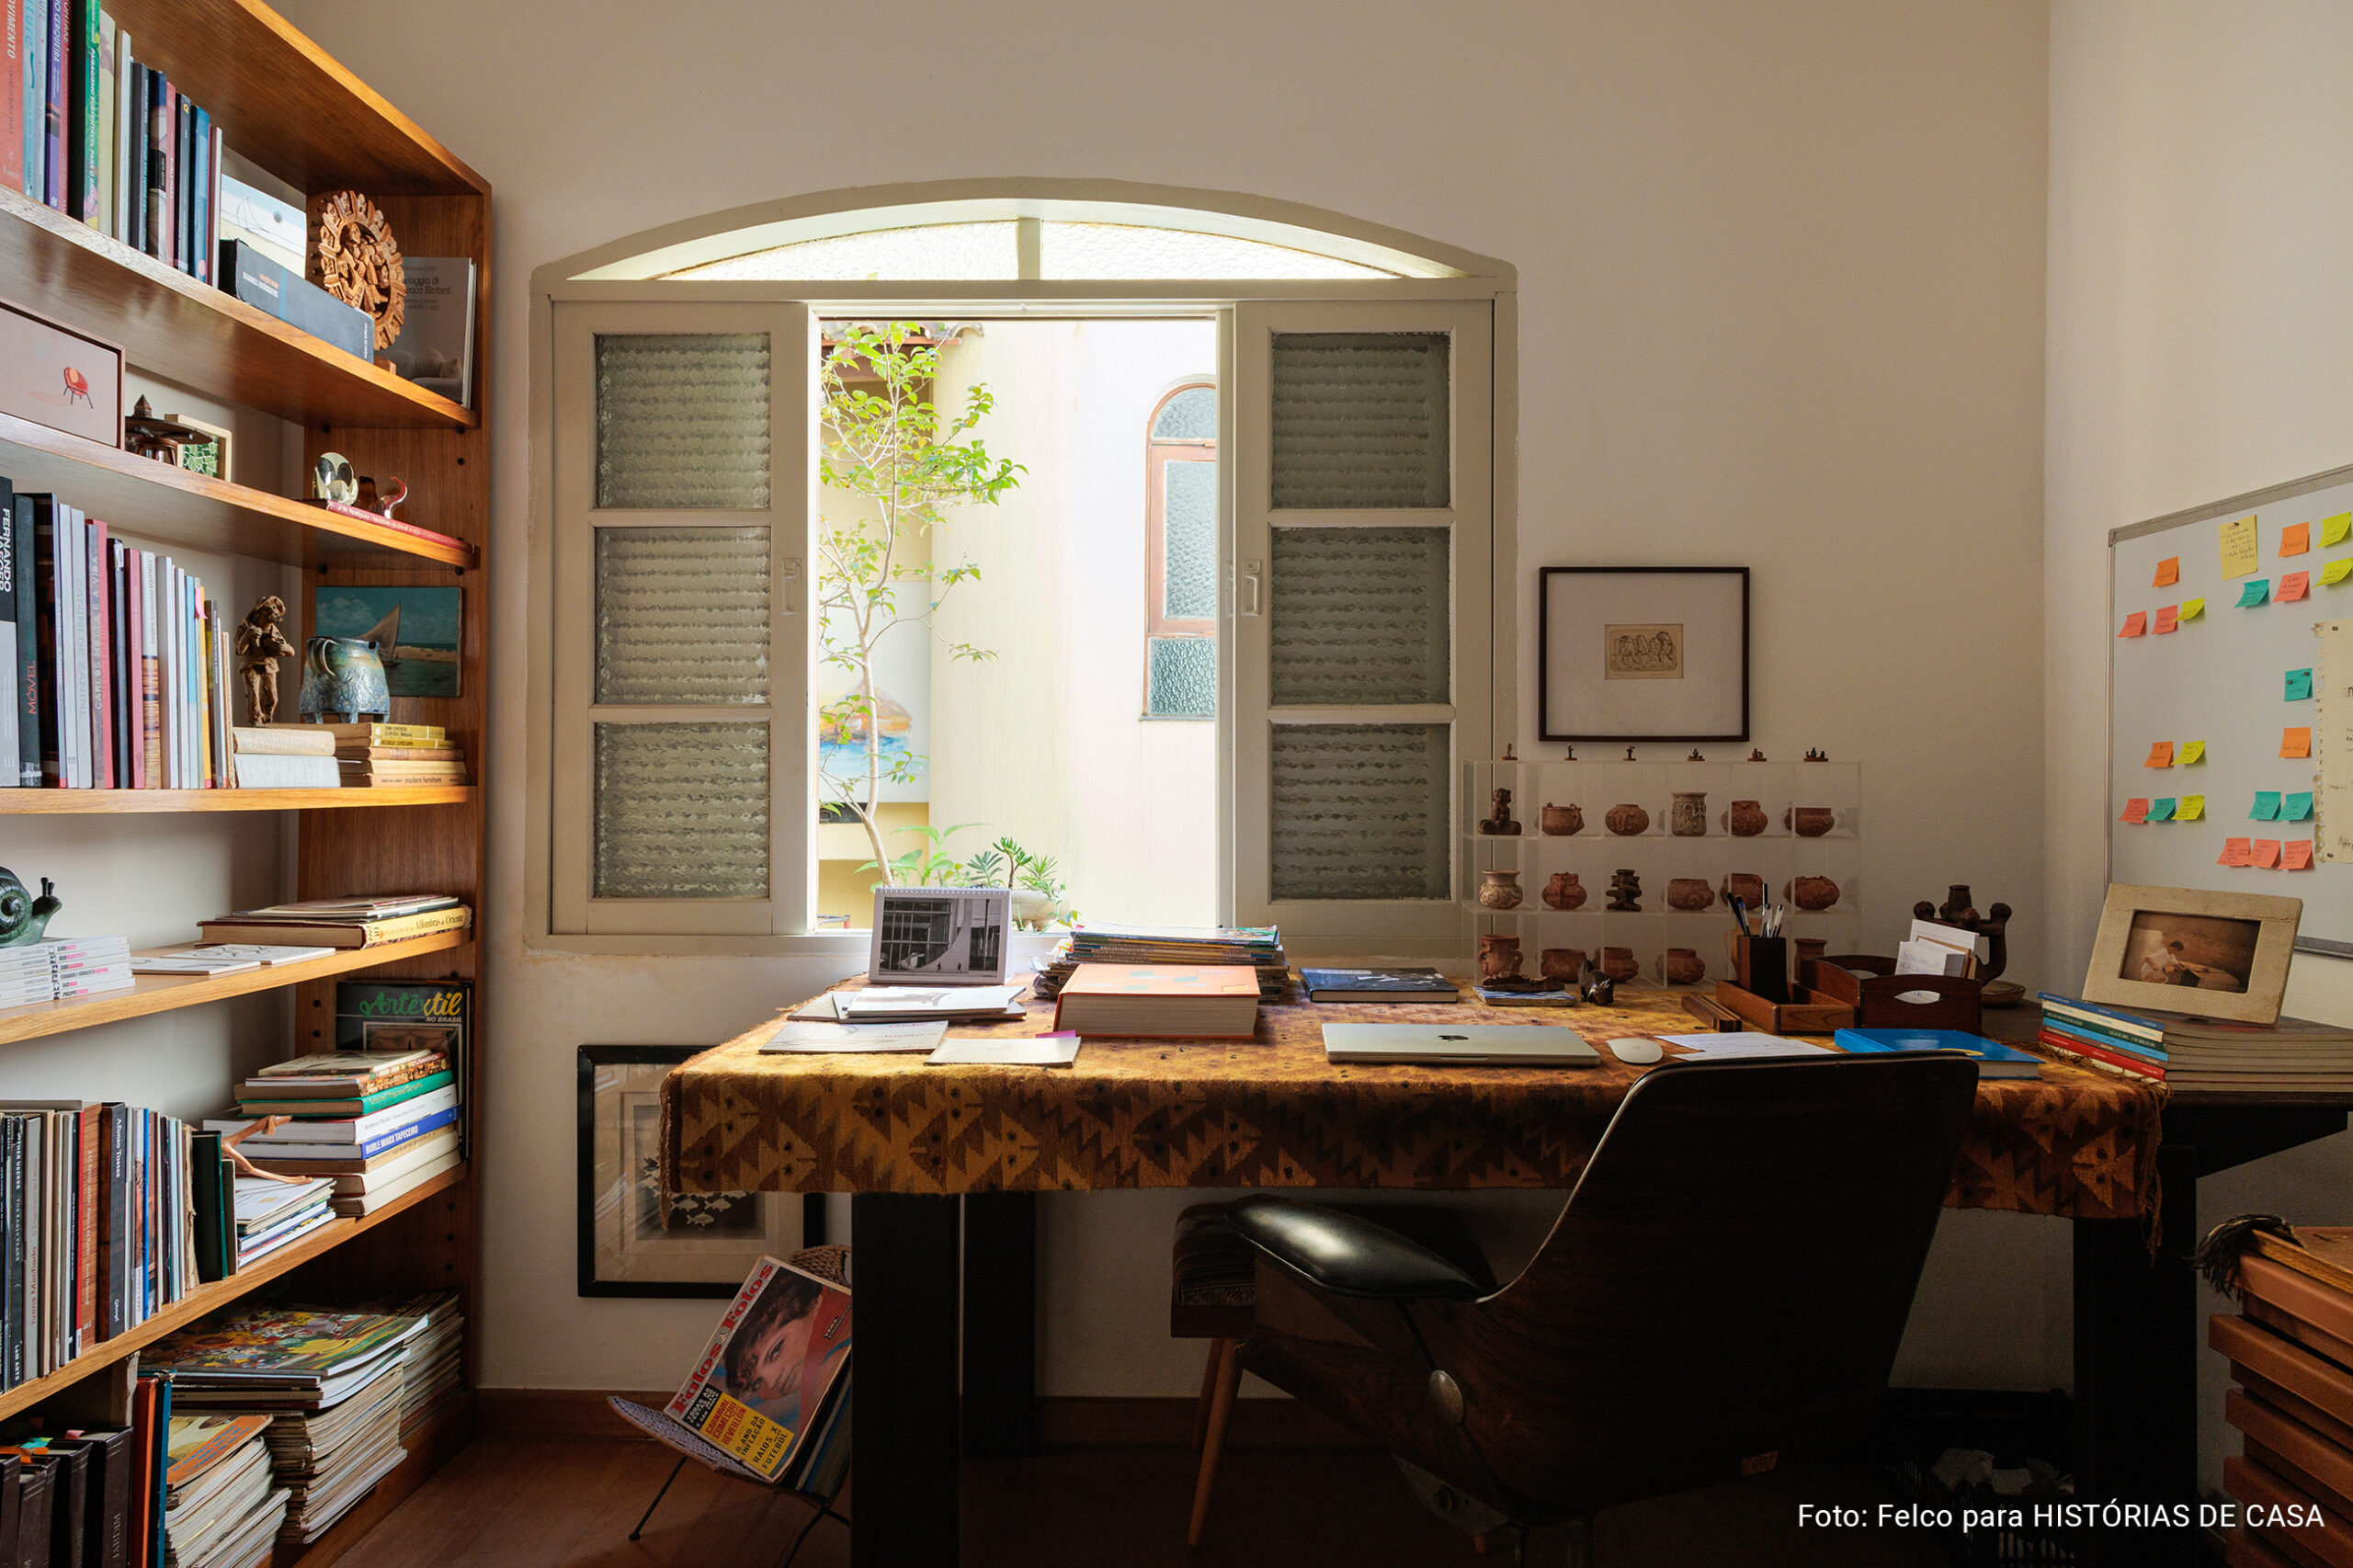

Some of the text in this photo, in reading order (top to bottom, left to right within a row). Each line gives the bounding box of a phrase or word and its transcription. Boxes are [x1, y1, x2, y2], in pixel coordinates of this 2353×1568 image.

[75, 579, 85, 632] ZANINI
[77, 637, 85, 655] DE
[92, 616, 101, 657] MOTTA
[26, 660, 37, 715] MÓVEL
[94, 662, 102, 710] CARLOS
[366, 1140, 381, 1154] BURLE
[381, 1135, 395, 1148] MARX
[670, 1264, 774, 1415] Fatos Fotos
[703, 1398, 731, 1434] CARNAVAL
[749, 1415, 760, 1426] DA
[751, 1435, 774, 1463] RAIOS
[760, 1430, 789, 1470] FUTEBOL
